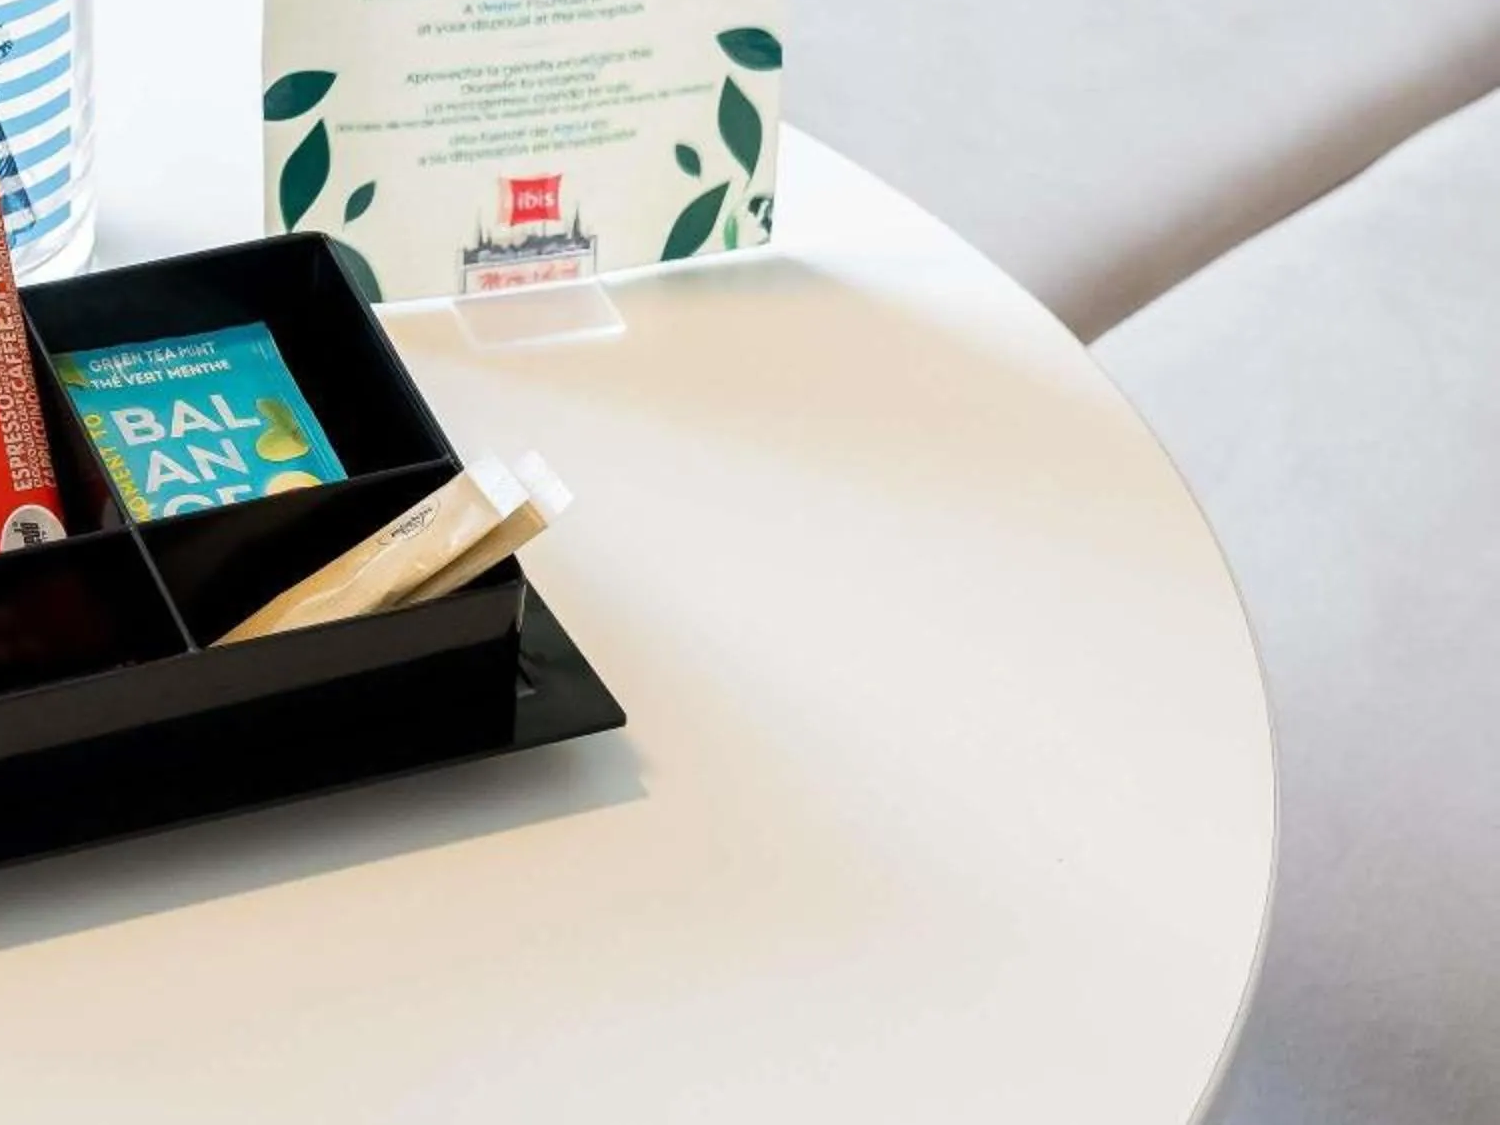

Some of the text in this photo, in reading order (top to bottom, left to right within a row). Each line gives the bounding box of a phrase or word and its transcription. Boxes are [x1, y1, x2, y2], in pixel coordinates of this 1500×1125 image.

[516, 190, 556, 212] ibis
[88, 349, 142, 373] GREEN
[146, 347, 177, 363] TEA
[126, 366, 165, 387] VERT
[166, 359, 232, 380] MENTHE
[109, 394, 262, 446] BAL
[145, 438, 249, 494] AN
